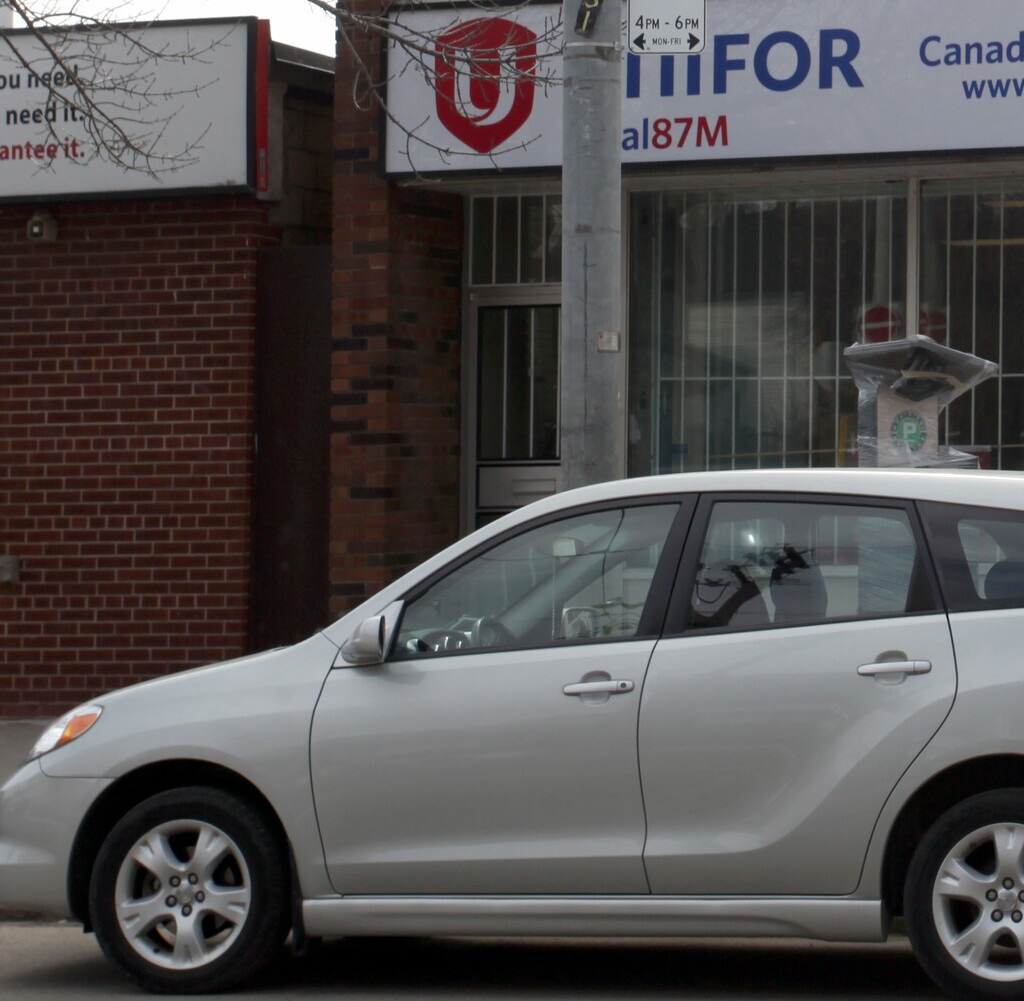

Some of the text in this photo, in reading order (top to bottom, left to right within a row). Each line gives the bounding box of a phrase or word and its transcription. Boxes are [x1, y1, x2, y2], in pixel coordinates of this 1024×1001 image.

[635, 15, 660, 30] 4PM
[675, 15, 699, 30] 6PM
[28, 64, 78, 88] need
[6, 101, 84, 125] need it.
[621, 115, 729, 151] al87M
[0, 137, 85, 160] antee it.
